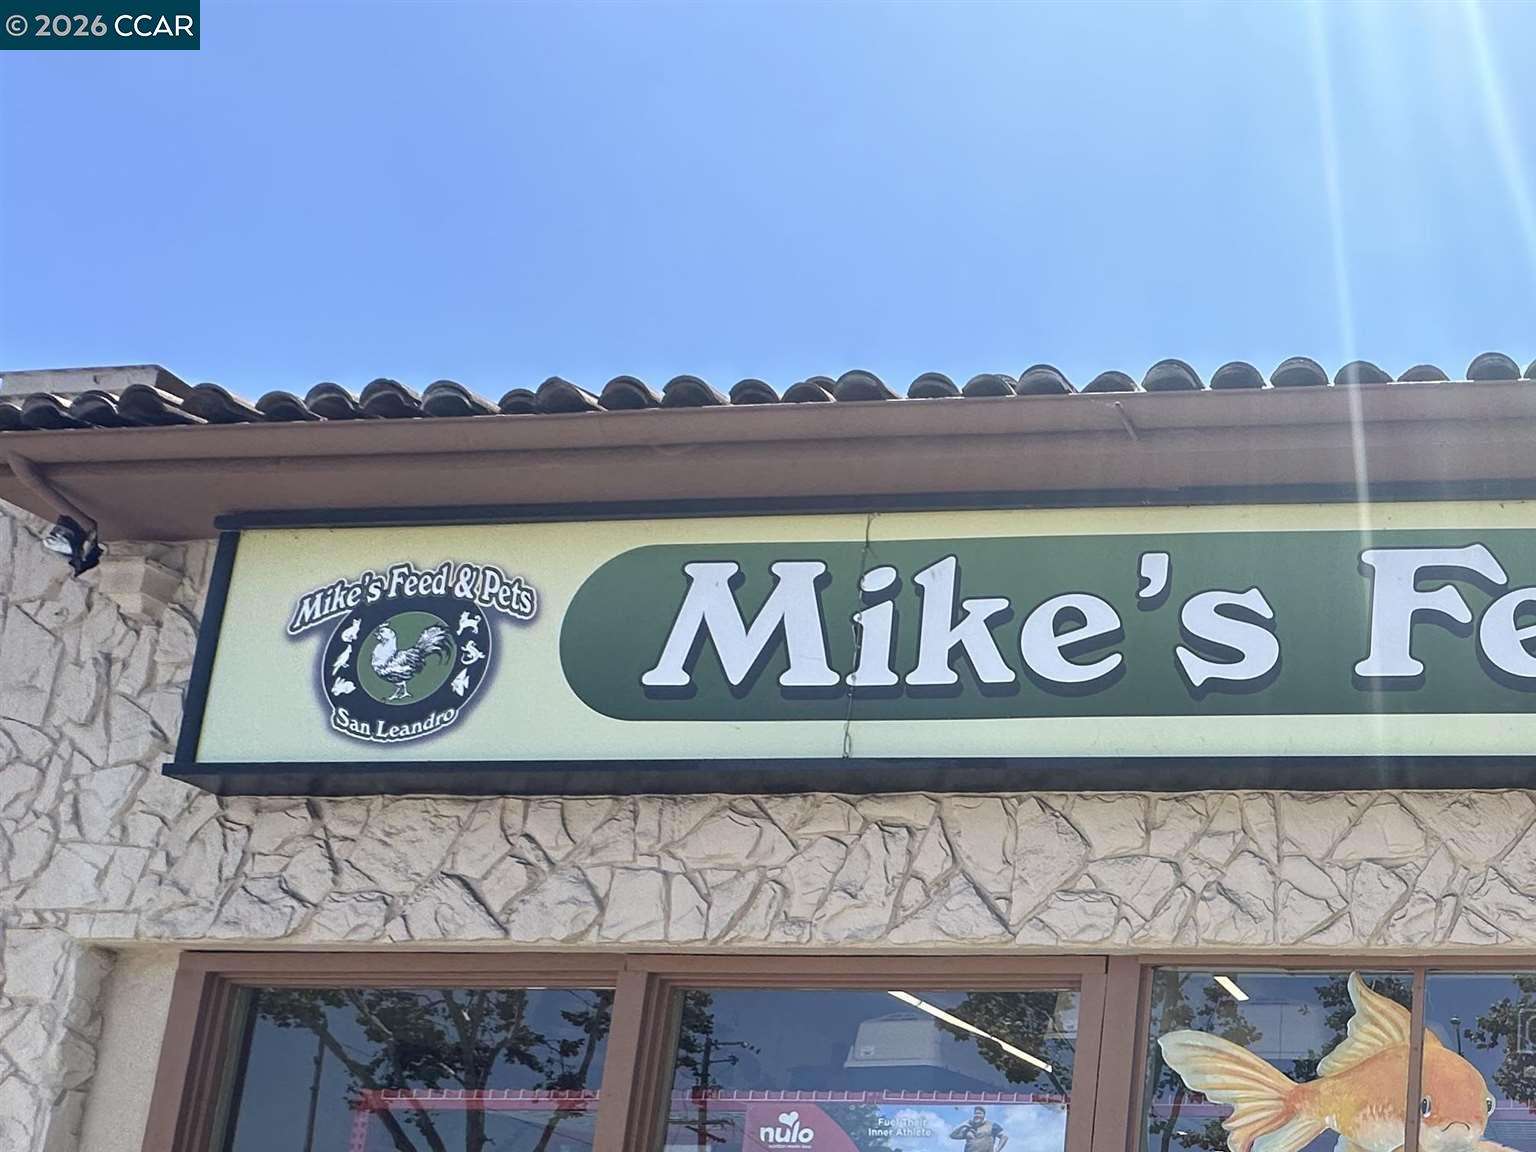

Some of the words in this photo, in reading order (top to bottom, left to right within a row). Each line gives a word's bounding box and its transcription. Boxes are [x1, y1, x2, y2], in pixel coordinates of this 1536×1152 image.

[291, 573, 382, 629] Mike's
[387, 566, 447, 598] Feed
[454, 566, 476, 599] &
[481, 569, 535, 614] Pets
[641, 551, 1282, 688] Mike's
[335, 706, 371, 737] San
[376, 707, 456, 738] Leandro
[759, 1120, 815, 1144] nulo
